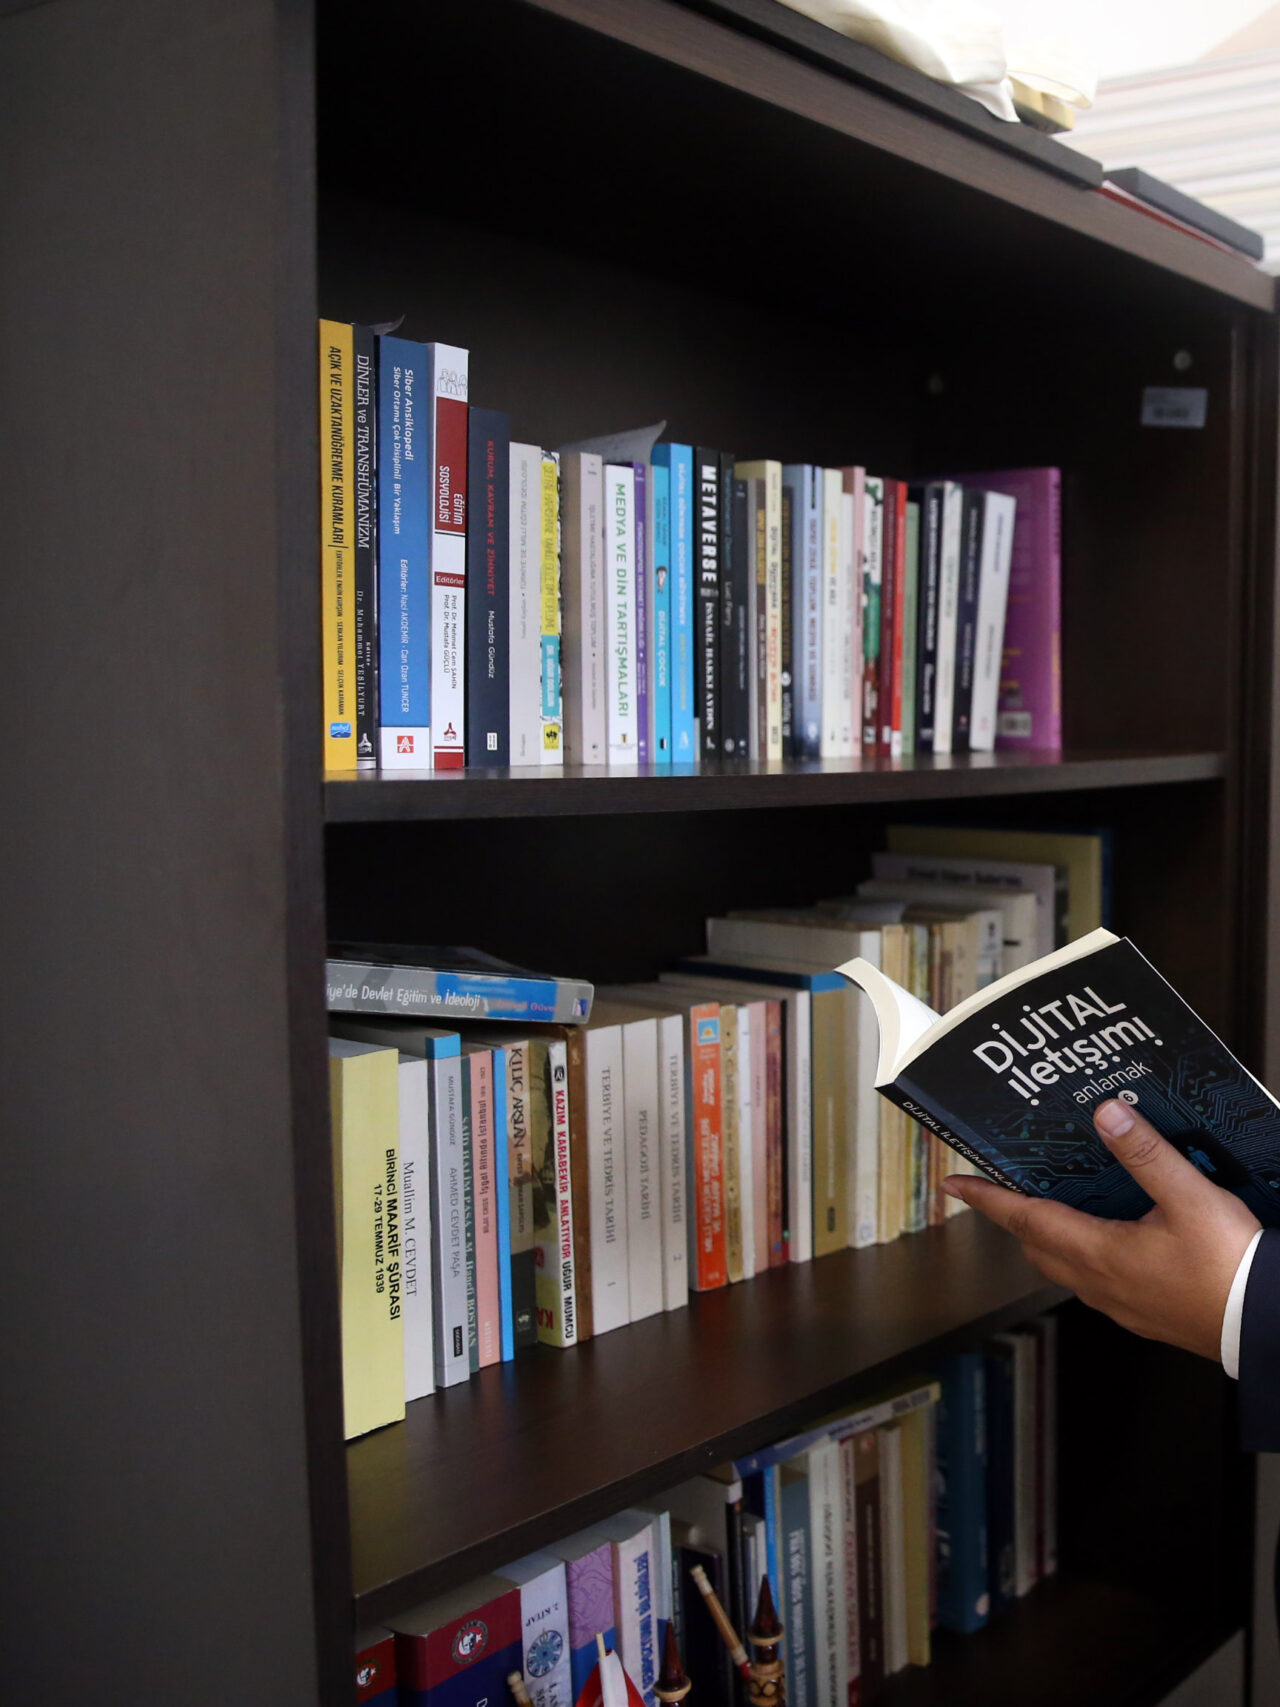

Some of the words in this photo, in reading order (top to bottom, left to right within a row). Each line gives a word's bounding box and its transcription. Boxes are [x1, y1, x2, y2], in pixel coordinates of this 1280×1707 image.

[328, 346, 342, 369] AÇIK
[330, 373, 342, 385] VE
[357, 355, 372, 405] DİNLER
[393, 367, 401, 387] Siber
[404, 369, 414, 397] Siber
[358, 409, 367, 423] ve
[393, 390, 401, 421] Ortama
[330, 388, 345, 482] UZAKTANÖĞRENME
[392, 424, 401, 440] Çok
[404, 398, 414, 460] Ansiklopedi
[392, 442, 402, 479] Disiplinli
[358, 426, 372, 549] TRANSHÜMANİZM
[393, 483, 401, 496] Bir
[439, 466, 450, 523] SOSYOLOJİSİ
[487, 484, 495, 527] KAVRAM
[331, 485, 344, 543] KURAMLARI
[393, 498, 402, 534] Yaklaşım
[453, 493, 465, 525] EĞİTİM
[616, 484, 627, 536] MEDYA
[701, 465, 717, 582] METAVERSE
[487, 532, 495, 544] VE
[616, 543, 627, 562] VE
[400, 559, 408, 593] Editörler:
[436, 576, 465, 586] Editörler
[616, 568, 628, 595] DİN
[401, 611, 410, 643] AKDEMİR
[615, 602, 628, 716] TARTIŞMALARI
[326, 983, 358, 1001] iye'de
[361, 985, 394, 1001] Devlet
[397, 988, 428, 1005] Eğitim
[431, 994, 442, 1005] ve
[444, 989, 481, 1012] İdeoloji
[972, 986, 1127, 1074] DİJİTAL
[509, 1048, 524, 1092] KILIÇ
[1072, 1060, 1152, 1104] anlamak
[555, 1090, 566, 1125] KAZIM
[602, 1067, 612, 1125] TERBİYE
[477, 1100, 487, 1137] İstanbul
[669, 1111, 680, 1126] VE
[902, 1101, 939, 1131] DİJİTAL
[603, 1128, 612, 1146] VE
[386, 1148, 398, 1196] BİRİNCİ
[557, 1131, 569, 1194] KARABEKİR
[374, 1184, 383, 1213] 17-29
[403, 1162, 415, 1214] Muallim
[450, 1167, 460, 1206] AHMED
[375, 1218, 384, 1265] TEMMUZ
[386, 1200, 401, 1257] MAARİF
[404, 1218, 416, 1235] M.
[450, 1208, 460, 1247] CEVDET
[560, 1199, 571, 1259] ANLATIYOR
[375, 1268, 385, 1293] 1939
[405, 1238, 417, 1296] CEVDET
[449, 1251, 461, 1278] PAŞA
[562, 1261, 573, 1292] UĞUR
[564, 1295, 574, 1339] MUMCU
